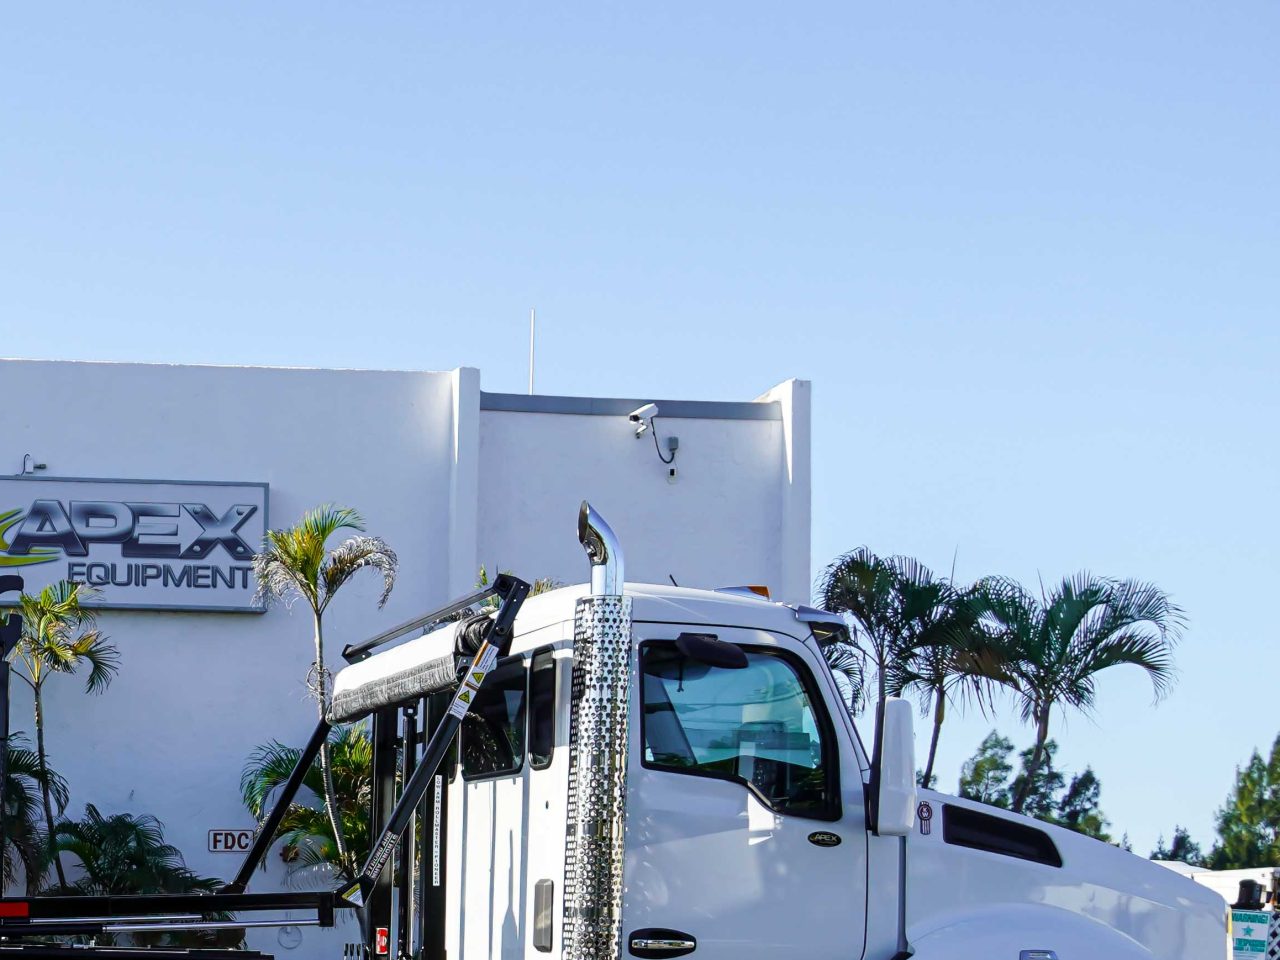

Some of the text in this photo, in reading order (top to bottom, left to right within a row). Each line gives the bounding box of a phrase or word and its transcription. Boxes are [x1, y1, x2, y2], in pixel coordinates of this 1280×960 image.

[7, 499, 259, 561] APEX
[67, 562, 254, 590] EQUIPMENT
[213, 832, 249, 850] FDC
